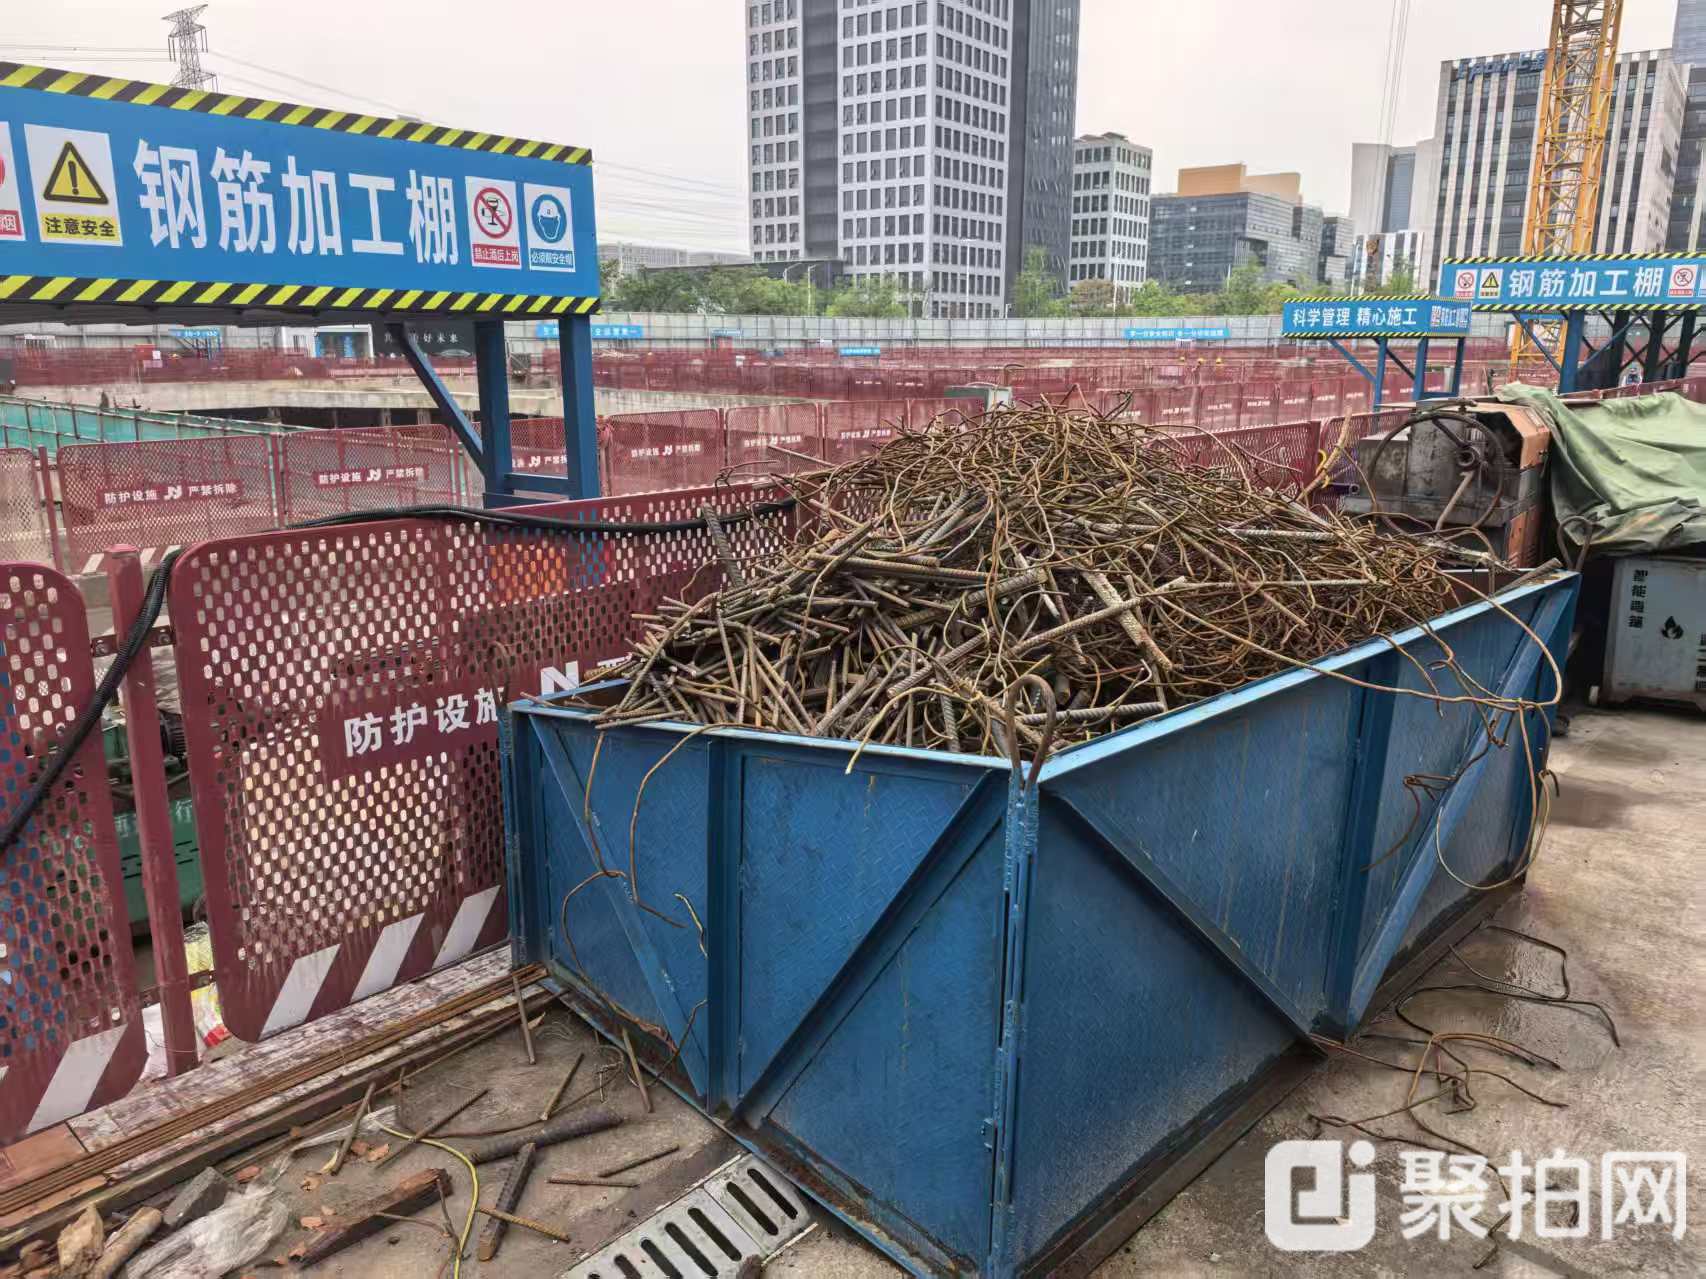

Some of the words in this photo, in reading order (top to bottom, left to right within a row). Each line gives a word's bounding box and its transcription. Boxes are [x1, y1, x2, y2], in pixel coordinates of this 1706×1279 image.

[133, 138, 459, 265] 钢筋加工棚
[45, 217, 115, 237] 注意安全
[1509, 267, 1664, 297] 钢筋加工棚
[1293, 308, 1350, 327] 科学管理
[1357, 306, 1418, 327] 精心施工
[104, 489, 157, 504] 防护设施
[344, 687, 505, 757] 防护设施
